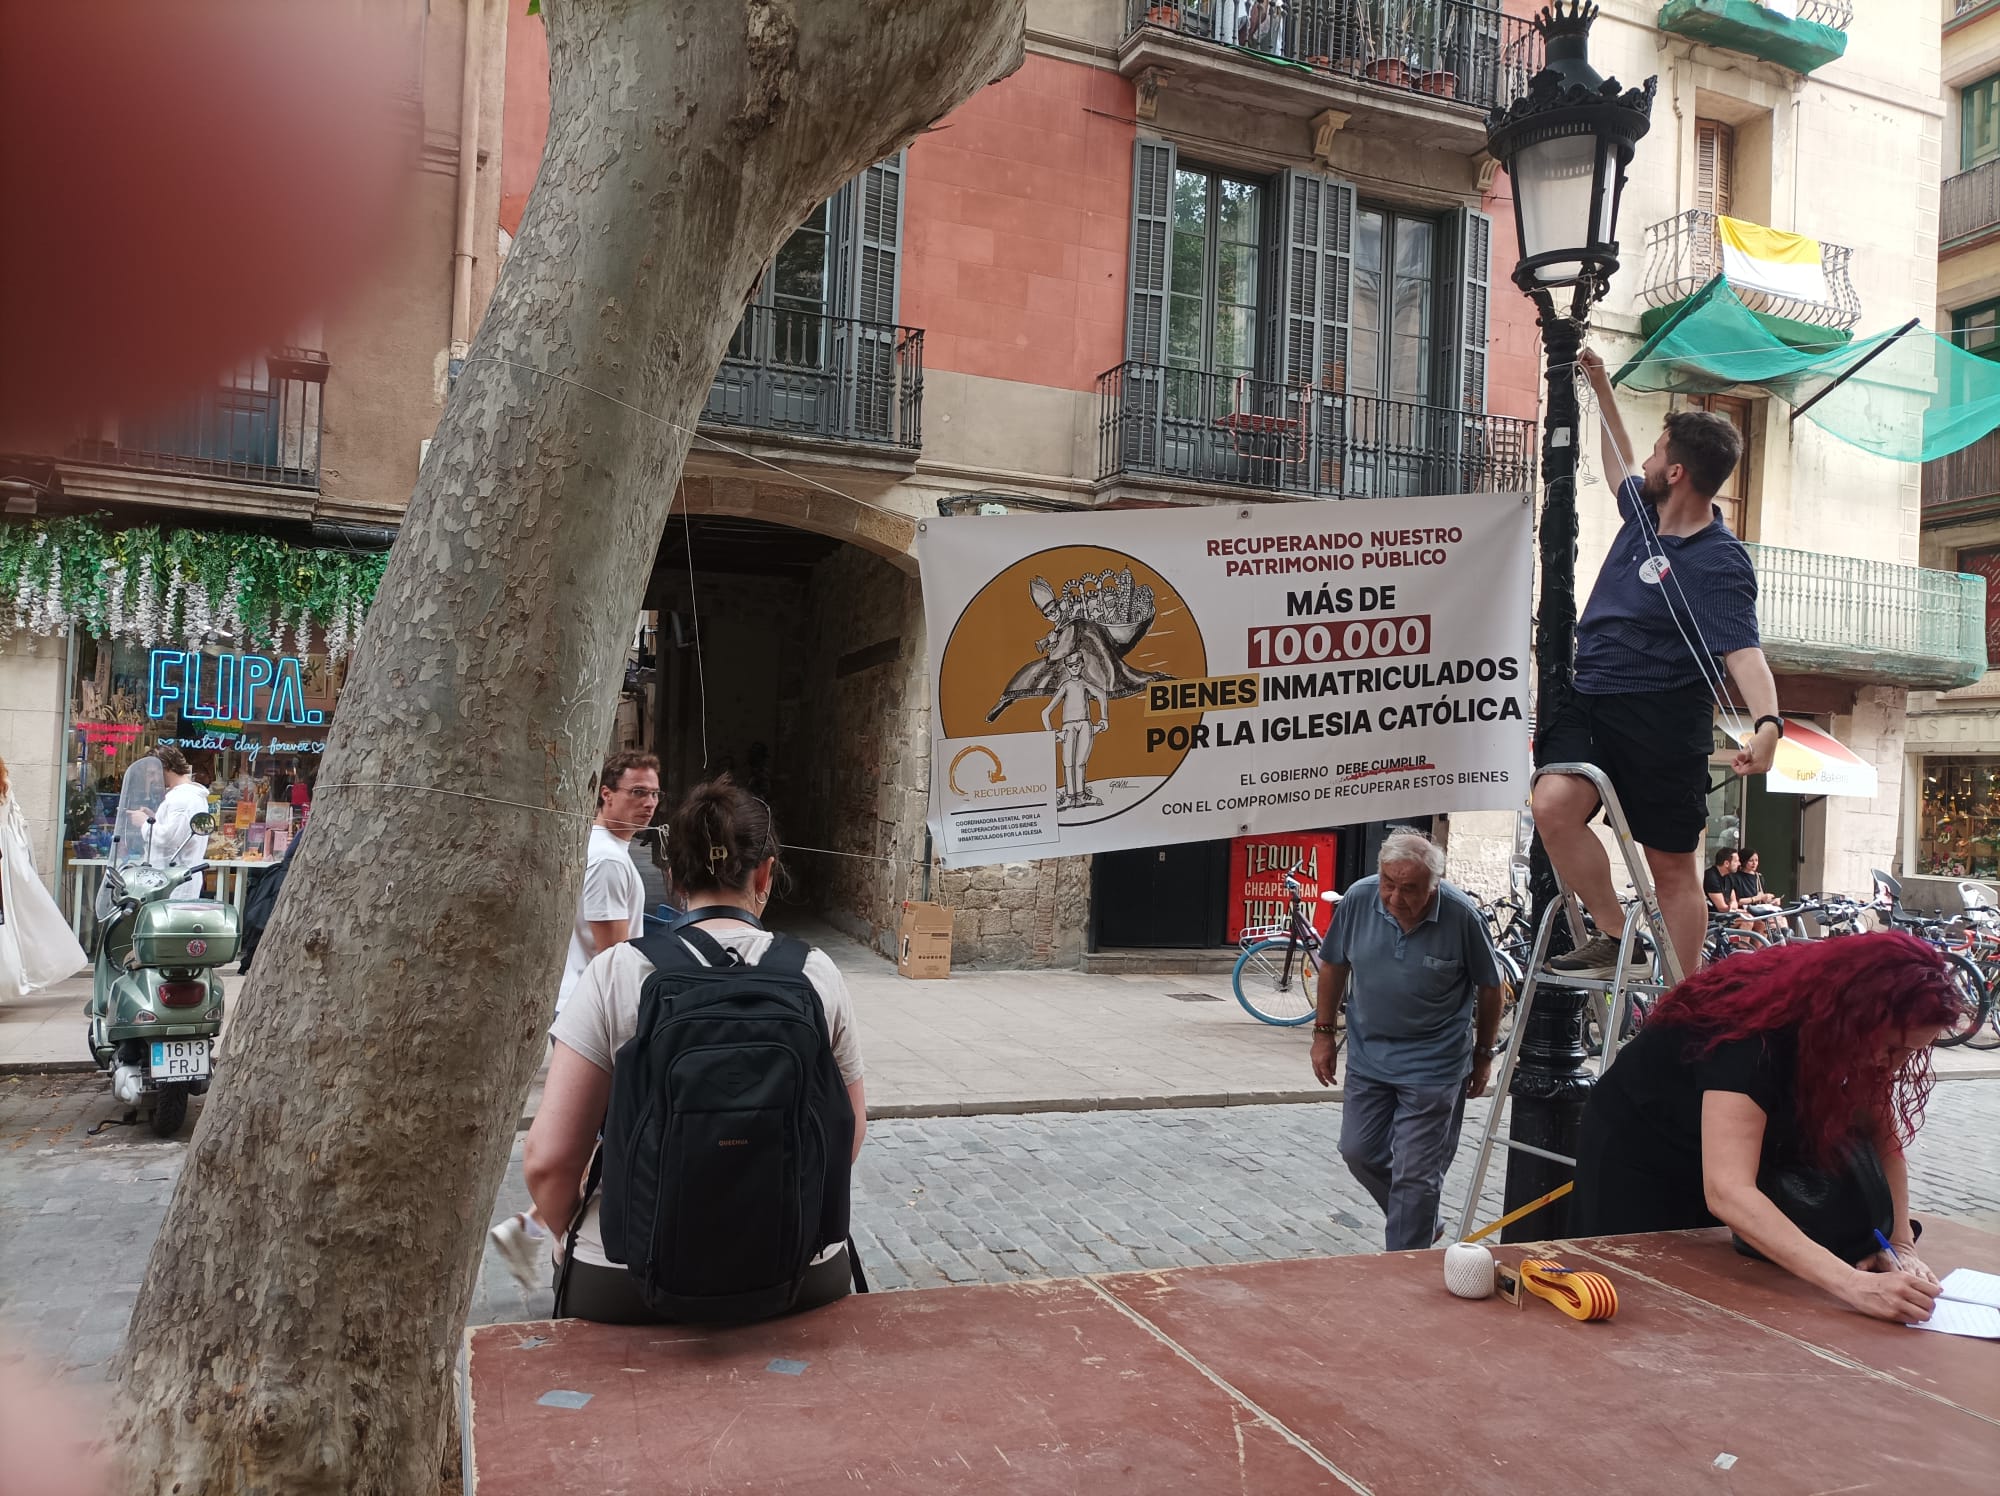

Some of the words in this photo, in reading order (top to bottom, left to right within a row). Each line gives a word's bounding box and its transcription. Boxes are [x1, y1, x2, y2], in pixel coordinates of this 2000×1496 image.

[1207, 532, 1363, 556] RECUPERANDO
[1370, 527, 1463, 547] NUESTRO
[1226, 554, 1354, 577] PATRIMONIO
[1362, 548, 1447, 569] PÚBLICO
[1287, 582, 1353, 617] MÁS
[1359, 585, 1396, 611] DE
[1253, 618, 1425, 665] 100.000
[149, 650, 323, 724] FLIPA.
[1150, 678, 1257, 711] BIENES
[1263, 656, 1518, 701] INMATRICULADOS
[1146, 724, 1210, 753] POR
[1216, 720, 1256, 748] LA
[1262, 709, 1372, 743] IGLESIA
[1378, 694, 1522, 732] CATÓLICA
[179, 733, 227, 750] metal
[234, 733, 262, 762] clay
[1240, 773, 1256, 786] EL
[1260, 766, 1329, 784] GOBIERNO
[1336, 761, 1369, 776] DEBE
[1371, 755, 1427, 771] CUMPLIR
[974, 784, 1047, 798] RECUPERANDO
[1162, 802, 1193, 815] CON
[1196, 801, 1212, 813] EL
[1216, 790, 1311, 811] COMPROMISO
[1314, 787, 1331, 800] DE
[1334, 779, 1410, 799] RECUPERAR
[1413, 773, 1454, 789] ESTOS
[1458, 770, 1509, 784] BIENES
[955, 818, 997, 827] COORDINADORA
[998, 815, 1020, 823] ESTATAL
[961, 824, 1000, 834] RECUPERACIÓN
[958, 833, 1003, 842] INMATRICULADOS
[1246, 844, 1318, 880] TEQUILA
[1277, 872, 1287, 881] IS
[1244, 881, 1290, 897] CHEAPER
[1297, 883, 1318, 898] HAN
[166, 1041, 205, 1058] 1613
[169, 1058, 200, 1075] FRJ
